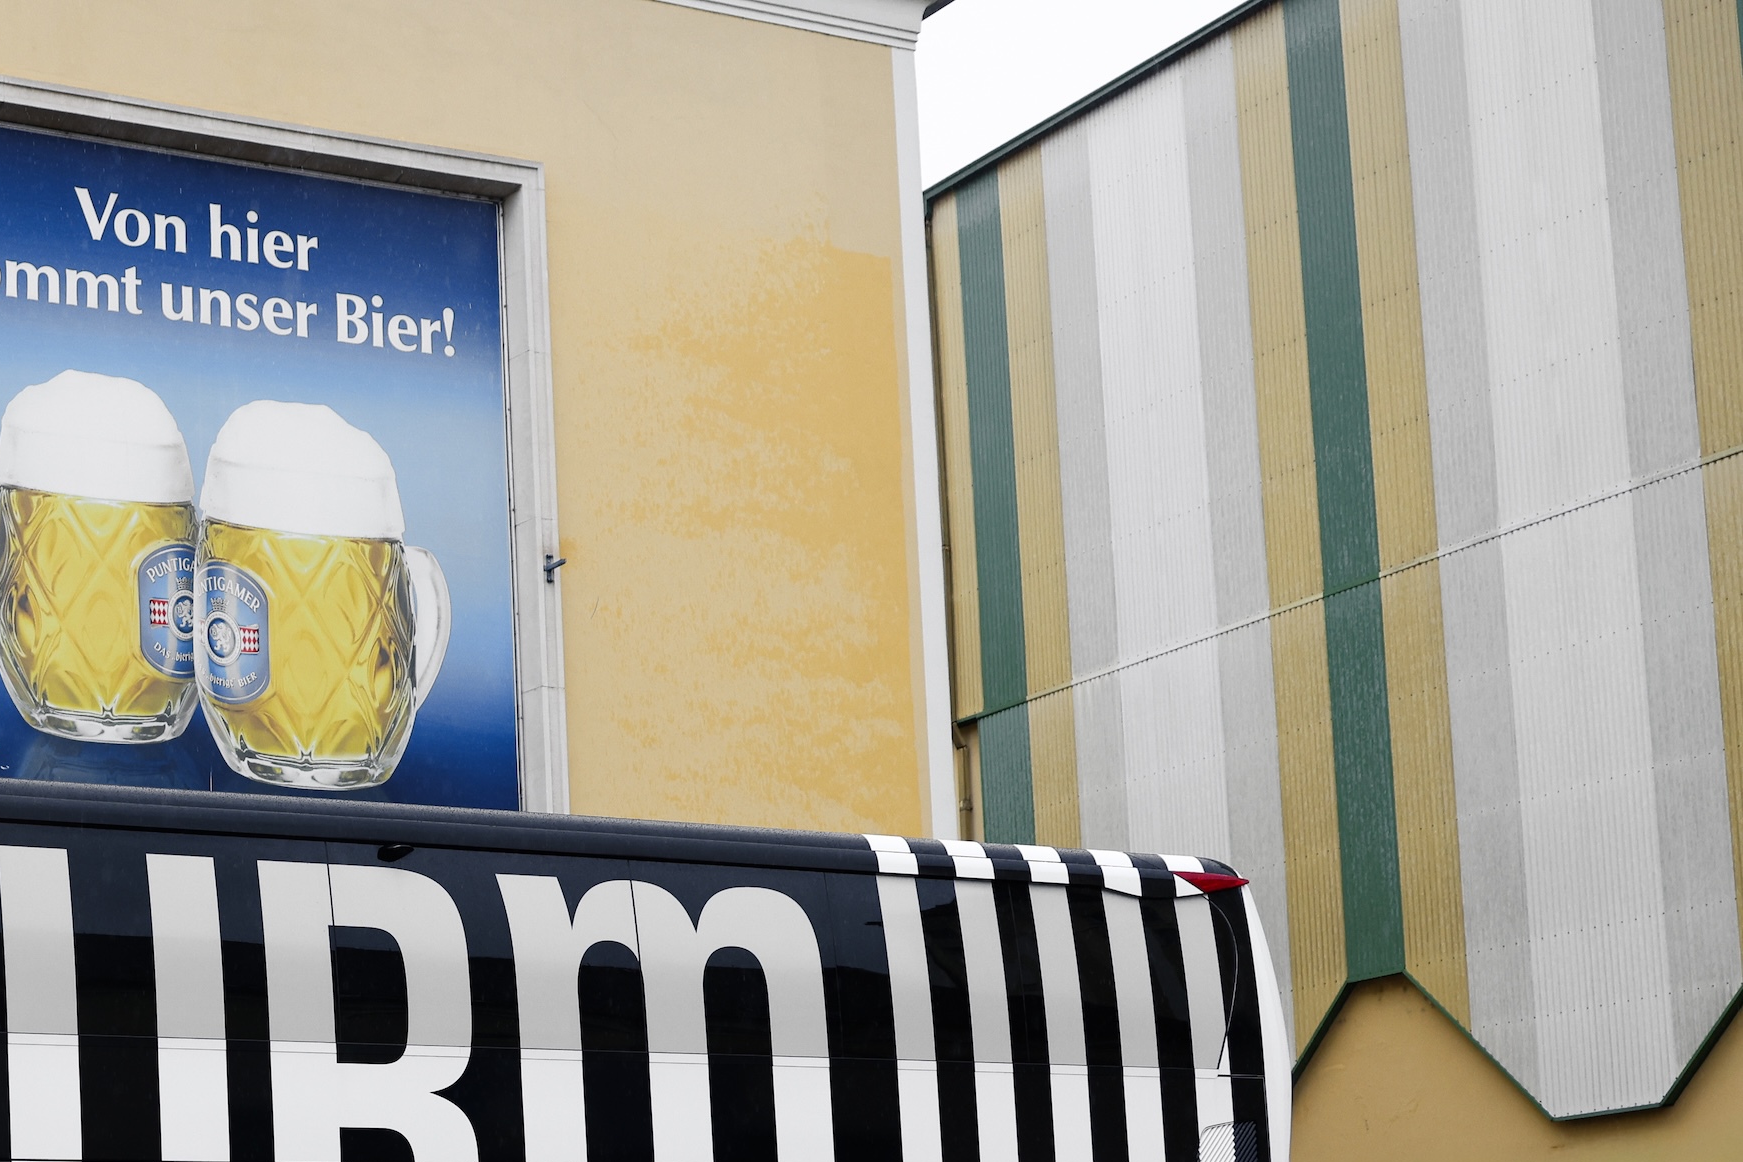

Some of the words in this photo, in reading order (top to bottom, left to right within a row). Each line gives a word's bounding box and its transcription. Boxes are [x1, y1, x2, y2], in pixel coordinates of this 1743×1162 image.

[72, 185, 187, 254] Von
[208, 203, 319, 271] hier
[160, 282, 317, 339] unser
[335, 293, 456, 358] Bier!
[154, 641, 171, 660] DAS
[238, 671, 257, 688] BIER
